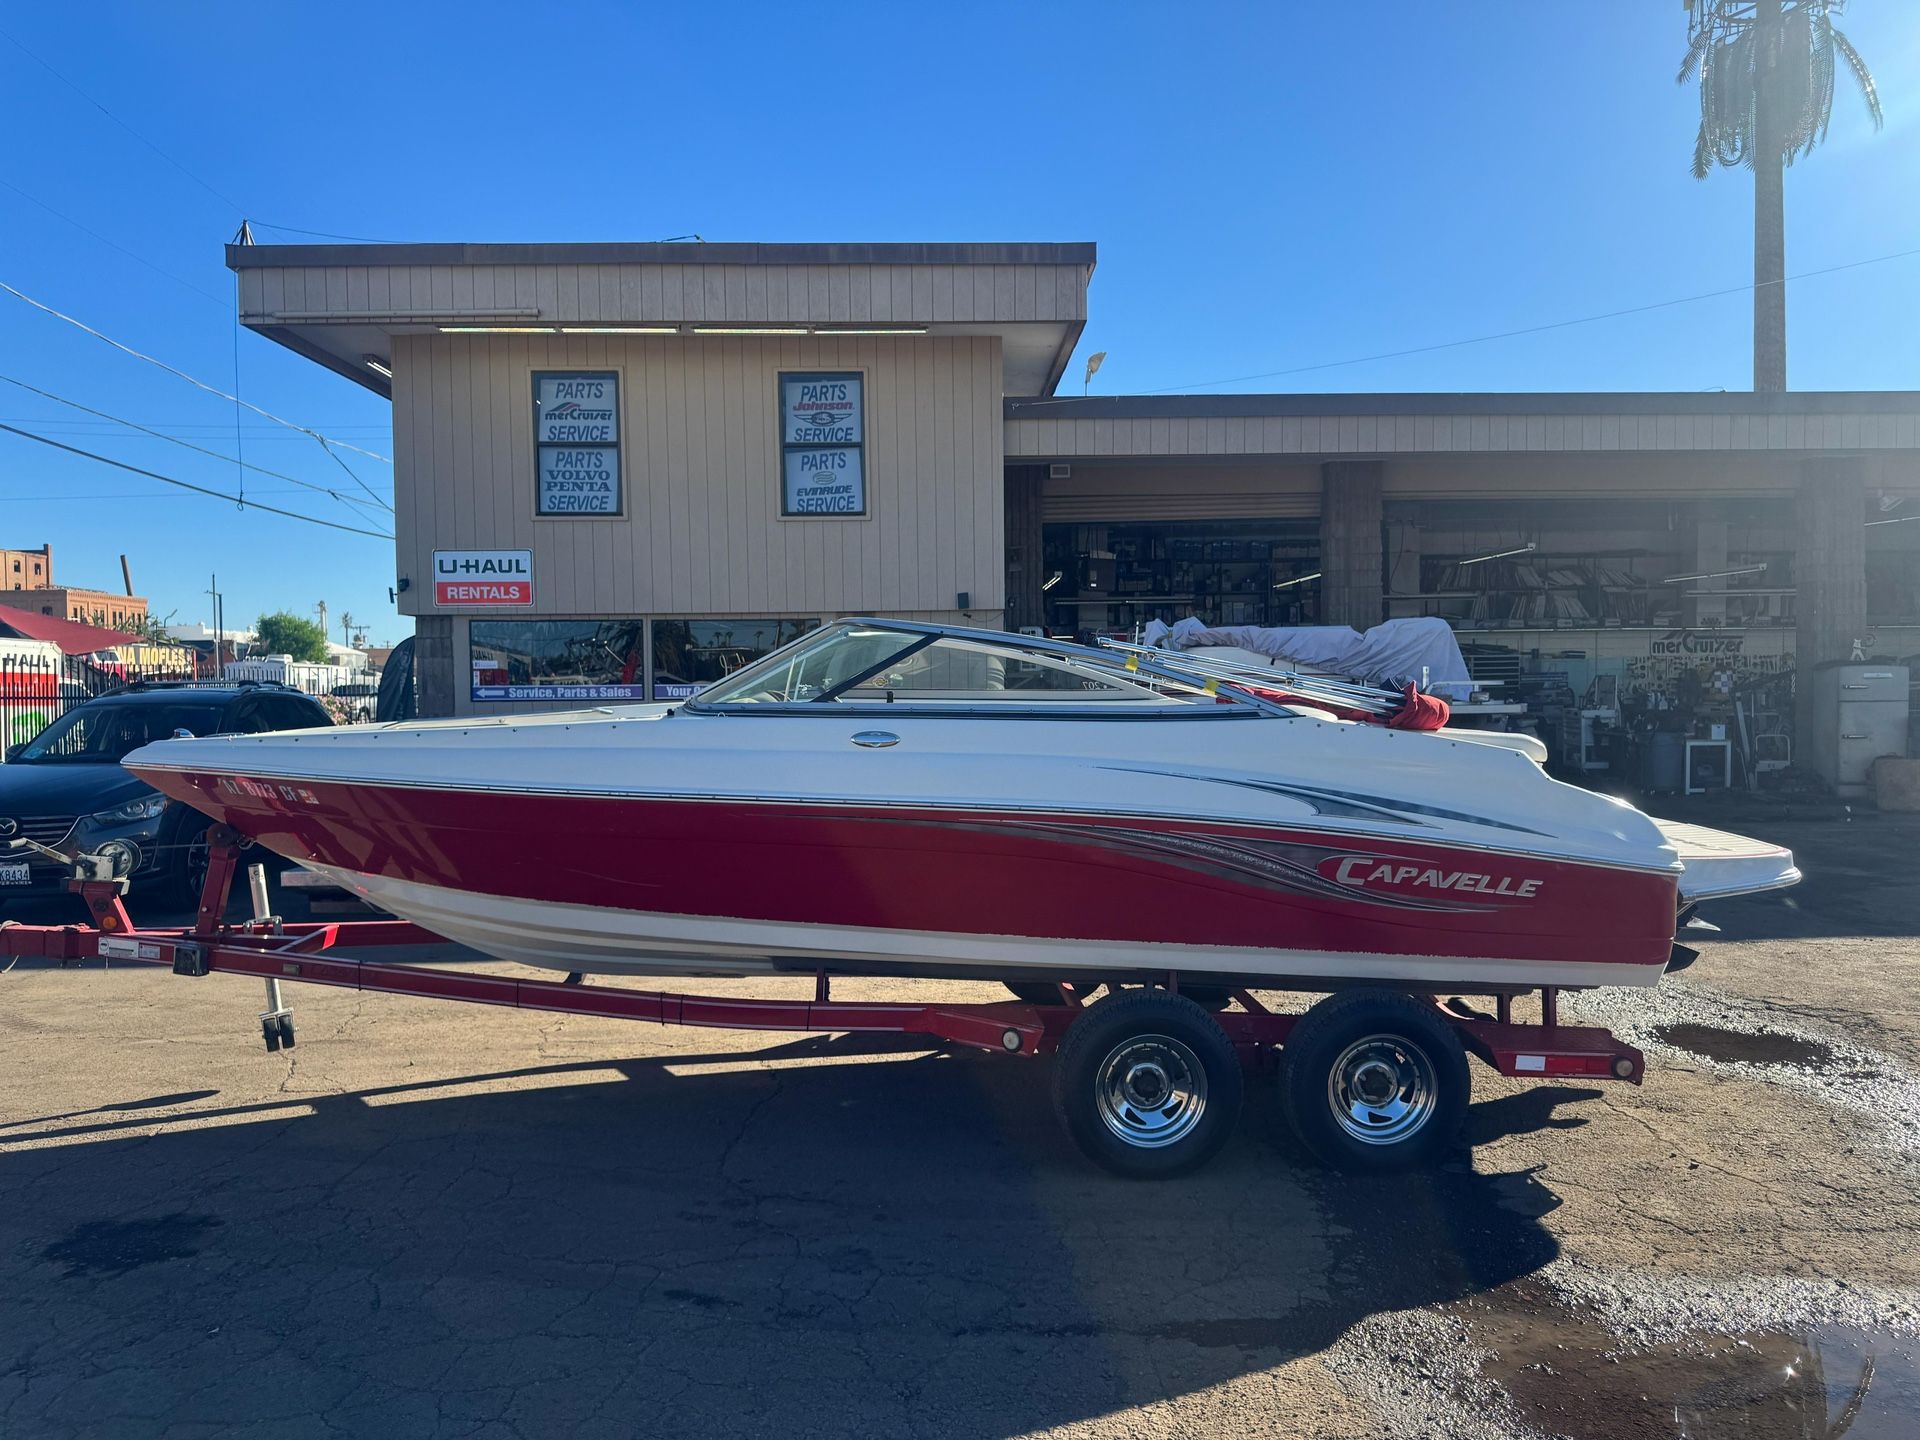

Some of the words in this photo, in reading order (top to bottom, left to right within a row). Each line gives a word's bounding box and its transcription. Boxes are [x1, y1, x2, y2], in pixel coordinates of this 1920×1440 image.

[555, 382, 604, 399] PARTS
[801, 384, 847, 402] PARTS
[547, 425, 610, 441] SERVICE
[794, 427, 854, 442] SERVICE
[555, 451, 604, 469] PARTS
[801, 452, 847, 471] PARTS
[546, 470, 611, 481] VOLVO
[545, 481, 612, 492] PENTA
[547, 495, 610, 511] SERVICE
[797, 495, 856, 512] SERVICE
[438, 559, 527, 574] U-HAUL
[447, 586, 520, 600] RENTALS
[140, 647, 186, 666] MOFLES
[508, 687, 555, 698] Service,
[557, 687, 587, 697] Parts
[589, 687, 598, 697] &
[600, 686, 632, 697] Sales
[666, 686, 692, 696] Your
